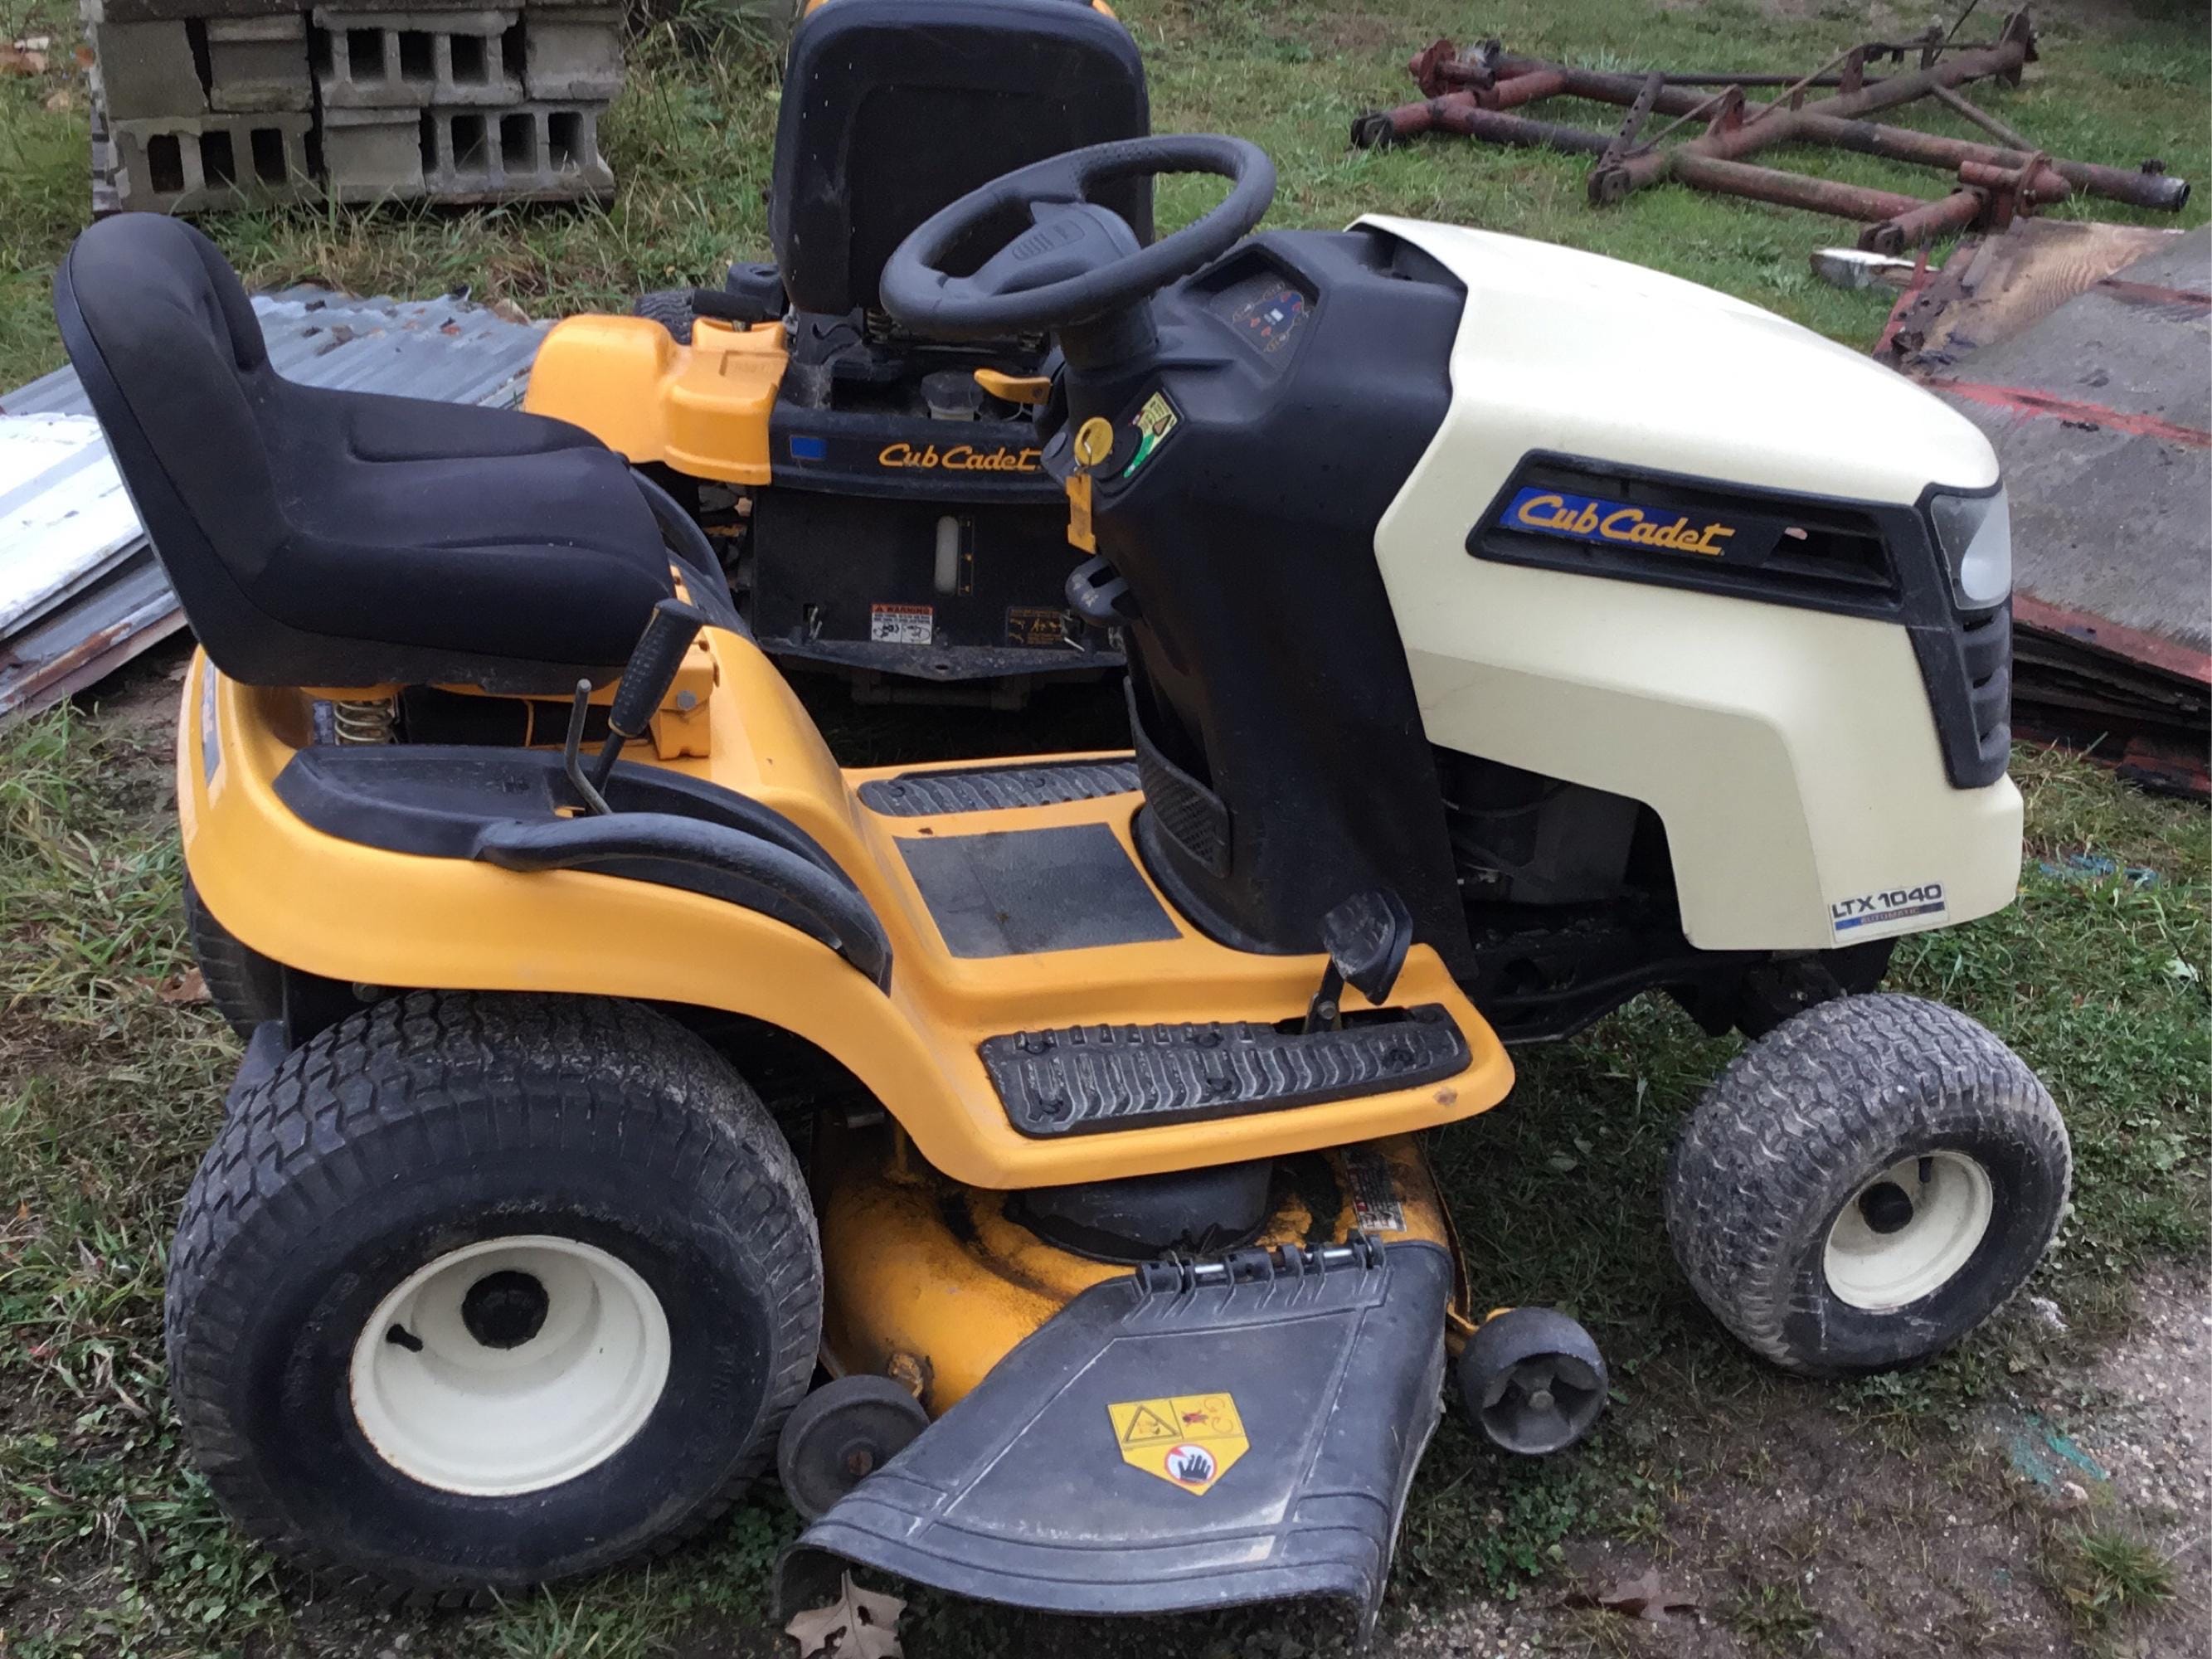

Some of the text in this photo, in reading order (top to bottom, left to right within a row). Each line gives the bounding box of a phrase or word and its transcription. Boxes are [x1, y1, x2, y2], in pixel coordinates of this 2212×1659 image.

[878, 443, 1043, 471] Cub Cadet
[1518, 495, 1736, 556] Cub Cadet
[1831, 884, 1942, 918] LTX 1040
